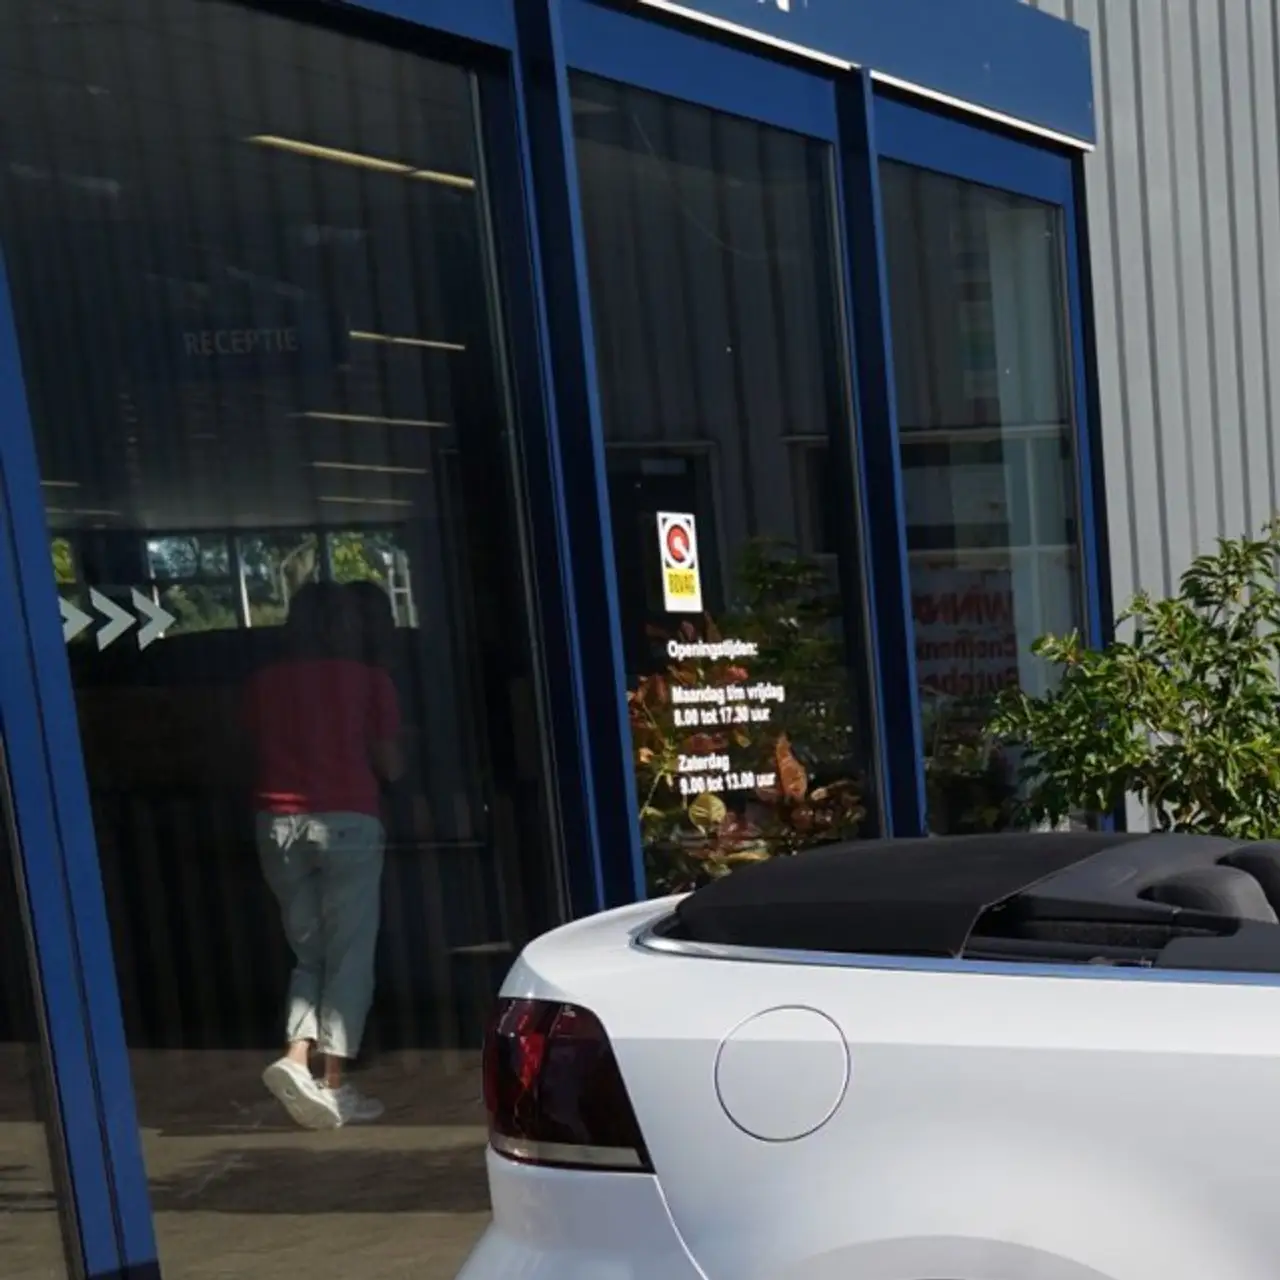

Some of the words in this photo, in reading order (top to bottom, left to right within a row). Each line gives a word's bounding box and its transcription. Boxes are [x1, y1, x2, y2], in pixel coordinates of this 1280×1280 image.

[183, 326, 299, 357] RECEPTIE
[667, 638, 758, 661] Openingstijden:
[671, 685, 725, 705] Maandag
[746, 681, 785, 703] vrijdag
[700, 708, 718, 724] tot
[719, 704, 749, 723] 17.30
[750, 707, 771, 721] uur
[678, 753, 730, 772] Zaterdag
[680, 777, 706, 795] 9.00
[706, 775, 724, 791] tot
[756, 772, 776, 787] uur
